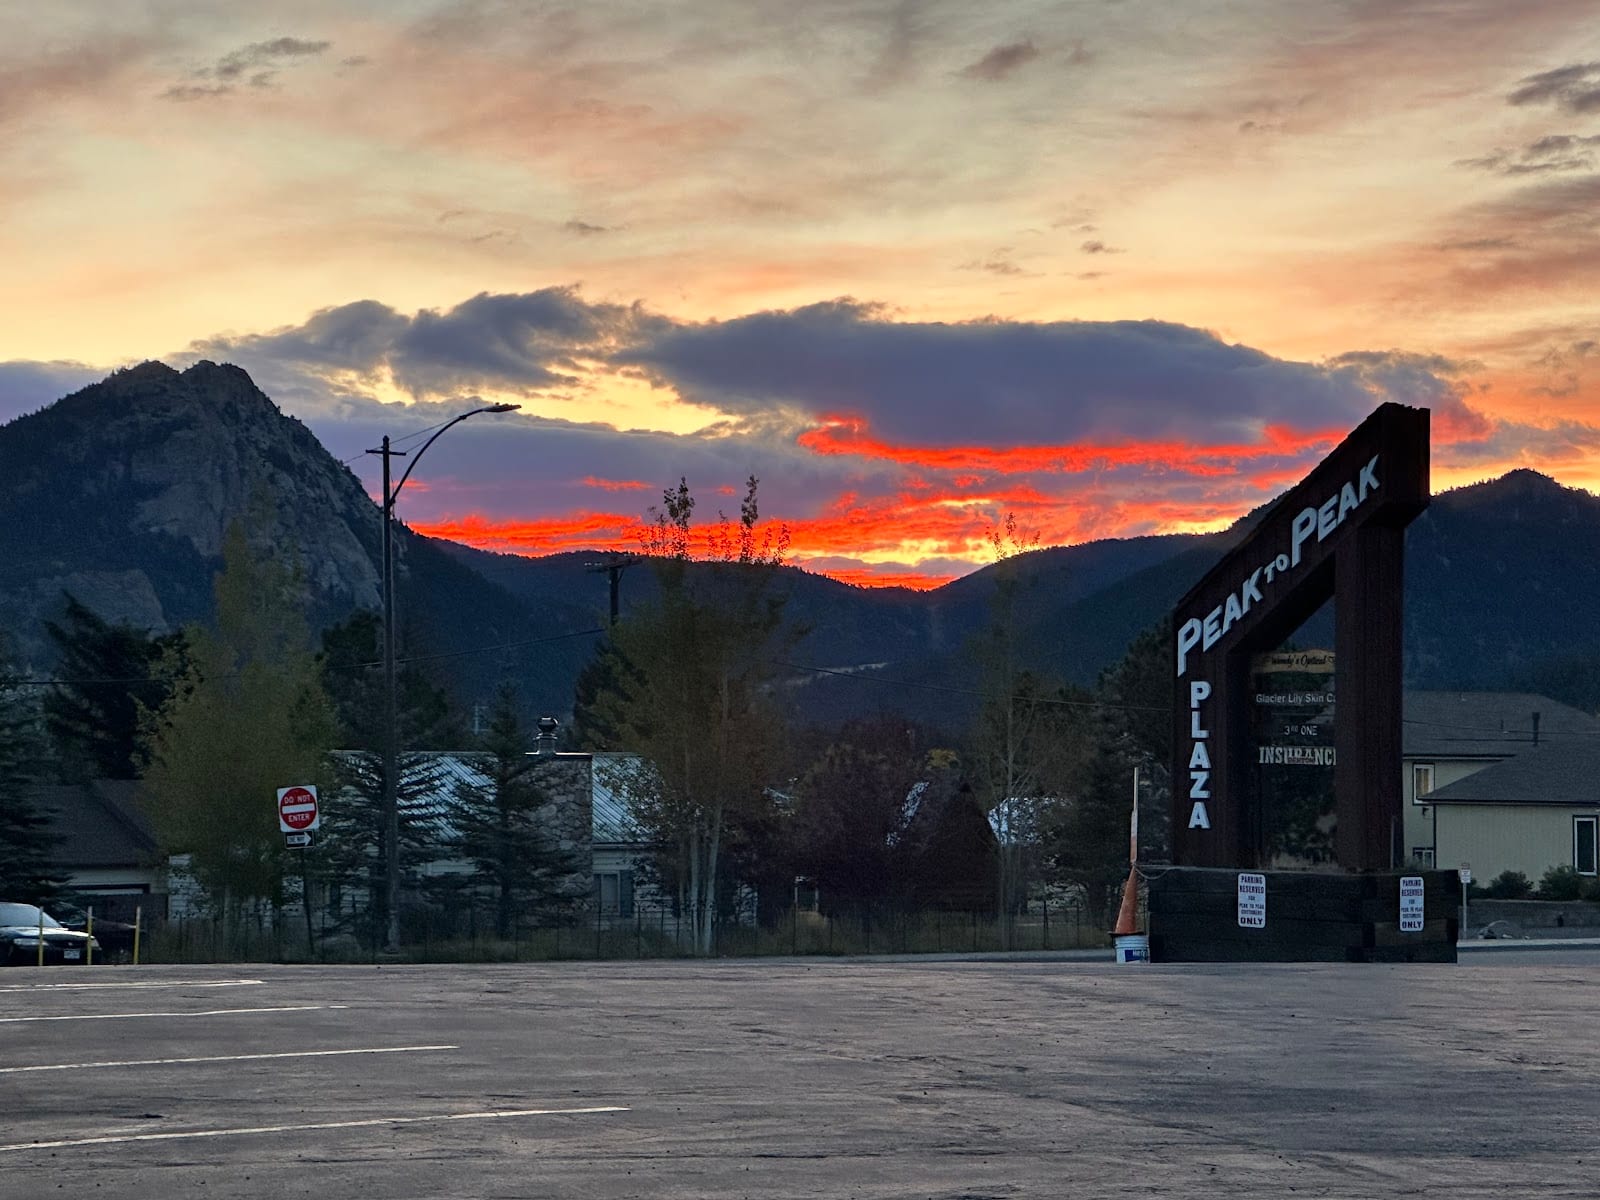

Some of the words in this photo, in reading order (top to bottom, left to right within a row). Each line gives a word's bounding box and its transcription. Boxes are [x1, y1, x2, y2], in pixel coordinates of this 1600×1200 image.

[1177, 565, 1264, 678] PEAK
[1263, 553, 1290, 584] TO
[1290, 453, 1381, 568] PEAK
[1301, 655, 1326, 668] Optical
[1256, 693, 1285, 703] Glacier
[1288, 693, 1303, 704] Lily
[1305, 693, 1324, 703] Skin
[1300, 724, 1318, 736] ONE
[1187, 680, 1213, 829] PLAZA
[284, 796, 295, 805] DO
[297, 794, 311, 803] NOT
[288, 813, 310, 823] ENTER
[1240, 875, 1263, 884] PARKING
[1402, 879, 1422, 887] PARKING
[1240, 885, 1264, 894] RESERVED
[1401, 889, 1423, 897] RESERVED
[1240, 917, 1263, 925] ONLY
[1402, 921, 1422, 929] ONLY
